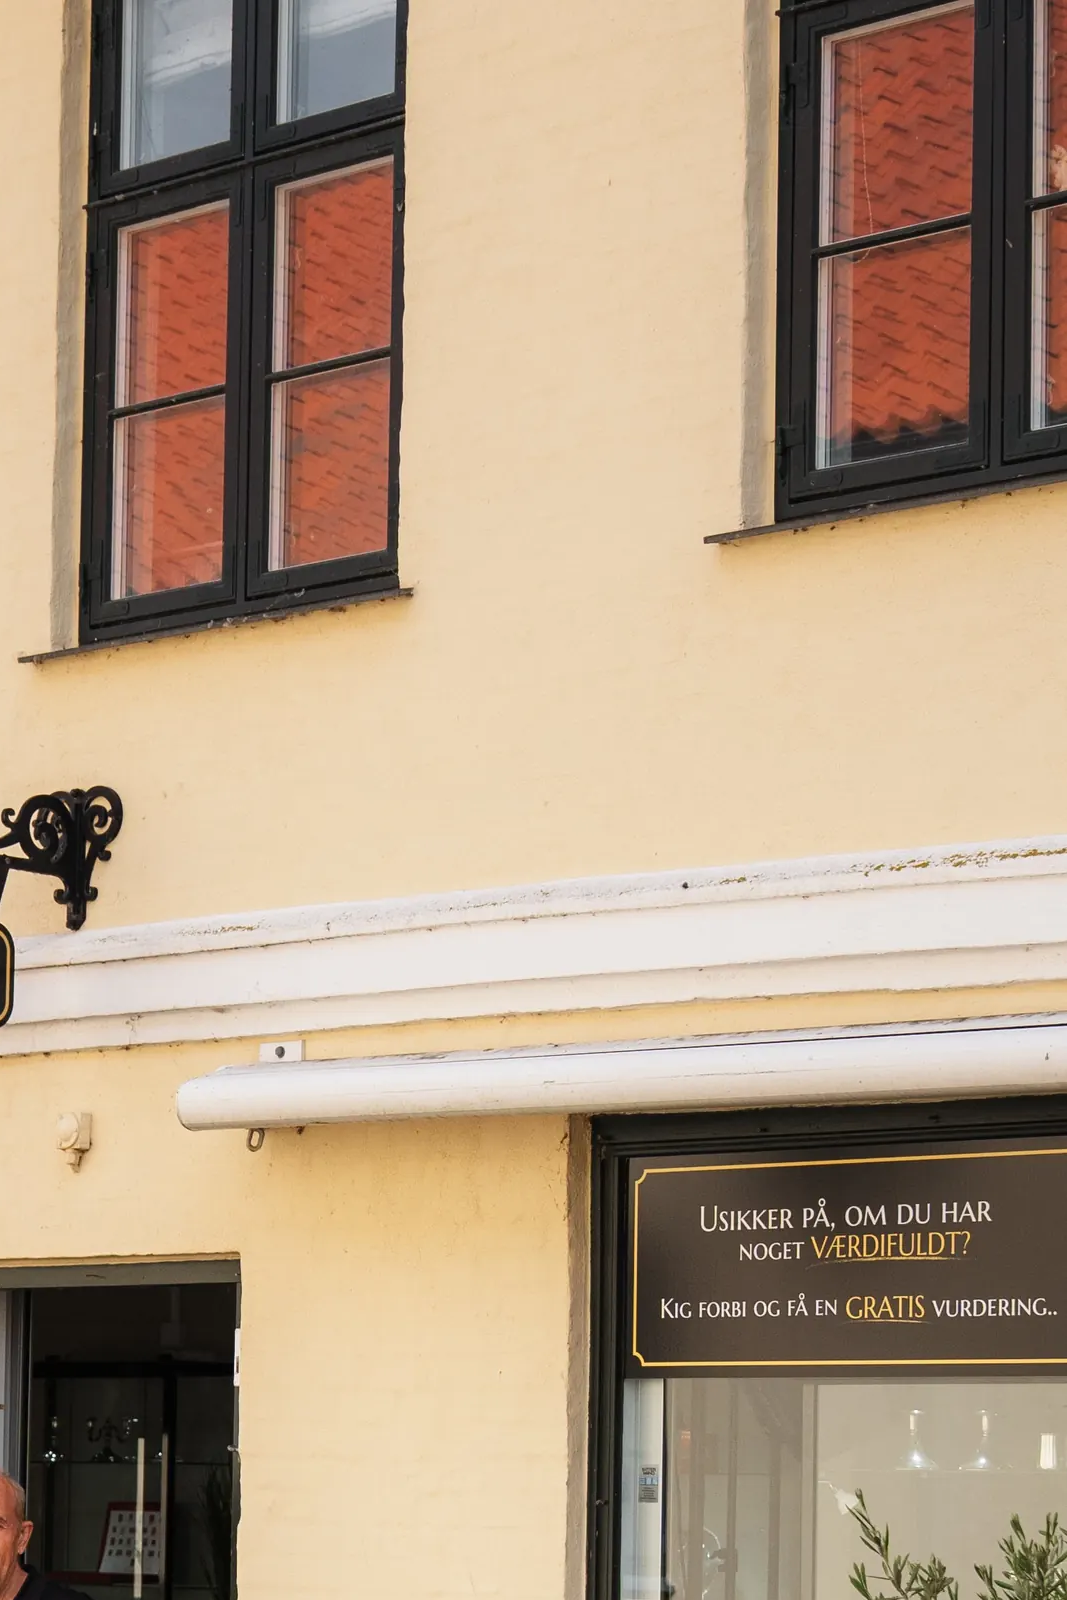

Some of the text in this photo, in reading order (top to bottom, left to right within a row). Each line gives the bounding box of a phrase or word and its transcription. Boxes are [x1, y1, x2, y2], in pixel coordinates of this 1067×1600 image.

[699, 1198, 993, 1232] USIKKER PÅ, OM DU HAR
[739, 1230, 971, 1261] NOGET VÆRDIFULDT?
[660, 1298, 692, 1319] KIG
[698, 1301, 747, 1319] FORBI
[753, 1300, 781, 1318] OG
[787, 1293, 809, 1317] FÅ
[815, 1299, 838, 1317] EN
[845, 1294, 926, 1320] GRATIS
